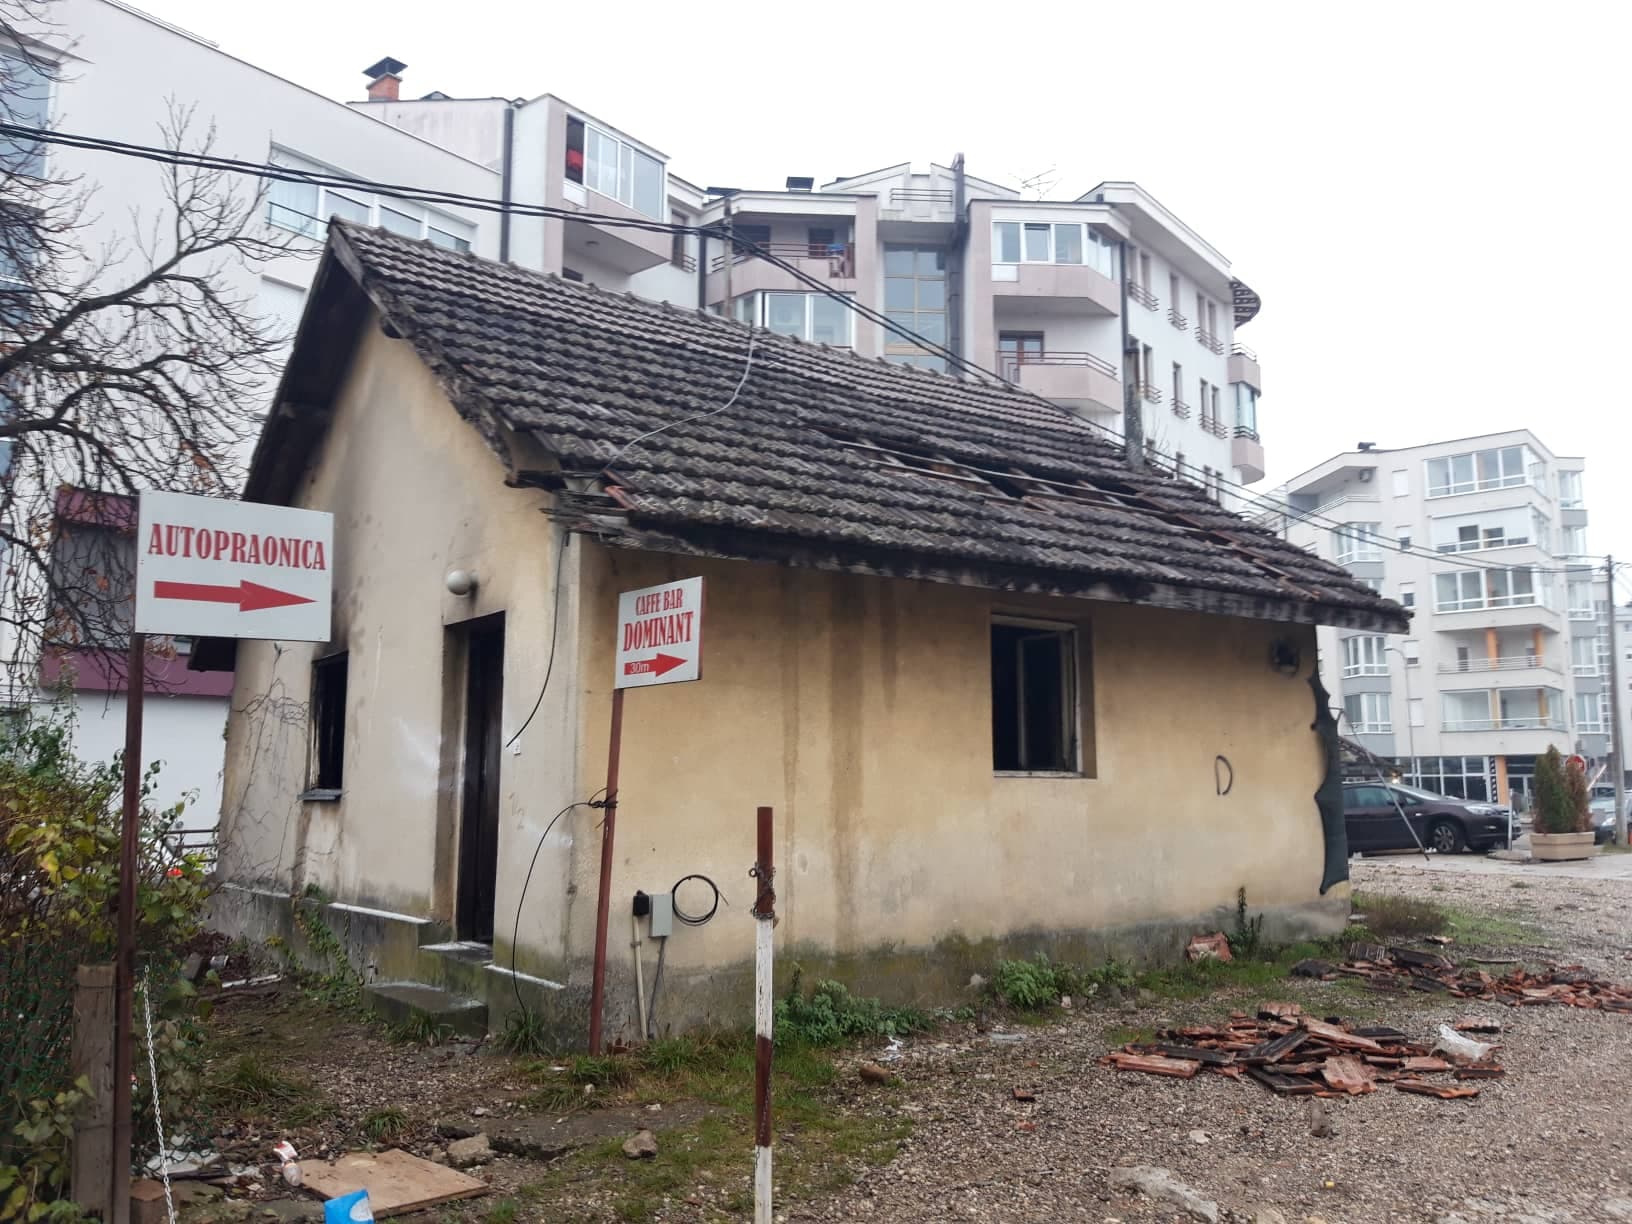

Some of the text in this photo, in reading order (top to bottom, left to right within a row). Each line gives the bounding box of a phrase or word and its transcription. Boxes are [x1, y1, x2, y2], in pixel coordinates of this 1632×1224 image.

[147, 523, 327, 571] AUTOPRAONICA
[635, 588, 683, 616] CAFFE BAR
[623, 611, 694, 652] DOMINANT
[630, 662, 650, 674] 30m
